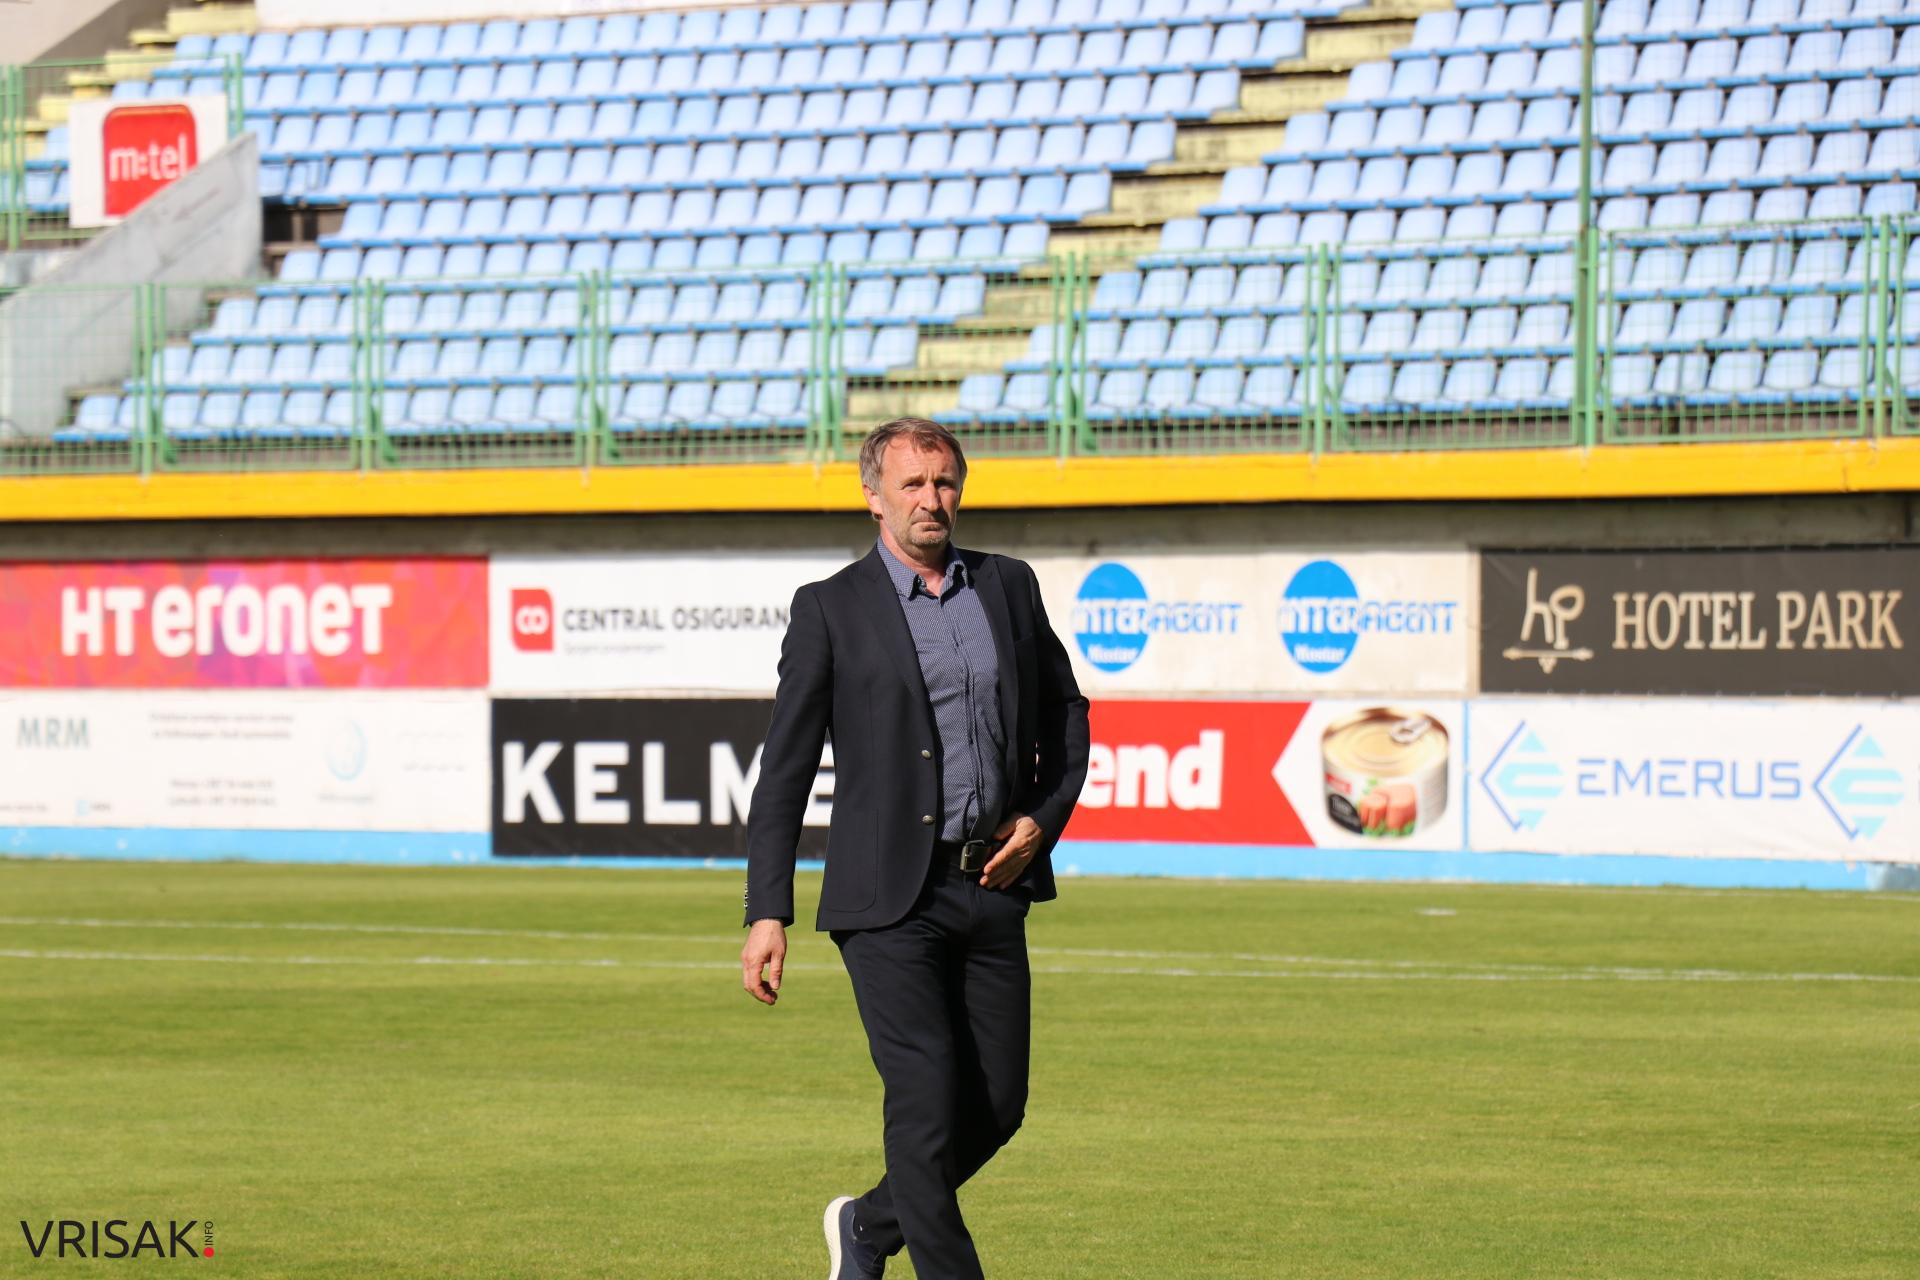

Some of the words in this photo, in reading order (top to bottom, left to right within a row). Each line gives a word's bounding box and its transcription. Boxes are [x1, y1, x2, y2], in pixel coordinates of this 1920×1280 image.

[109, 134, 187, 181] m:tel
[563, 608, 664, 631] CENTRAL
[1612, 592, 1767, 650] HOTEL
[1776, 591, 1903, 649] PARK
[17, 718, 90, 749] MRM
[1578, 759, 1800, 799] EMERUS
